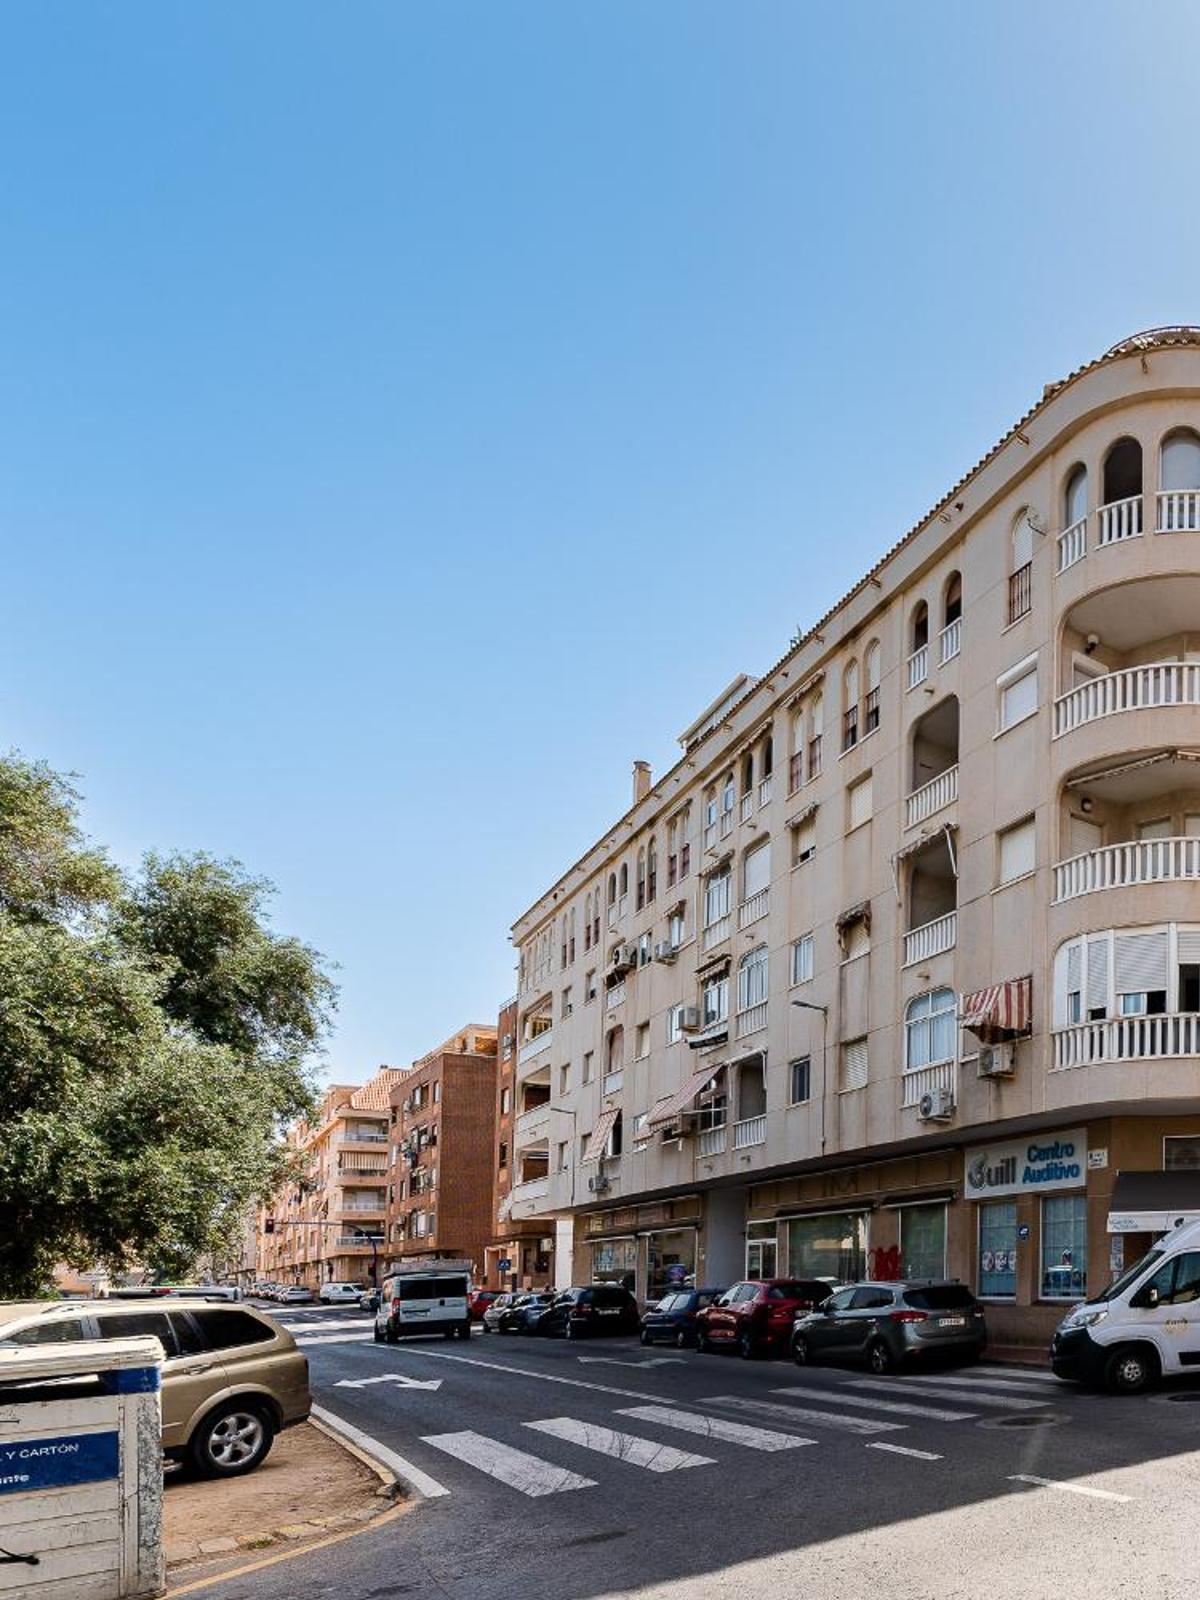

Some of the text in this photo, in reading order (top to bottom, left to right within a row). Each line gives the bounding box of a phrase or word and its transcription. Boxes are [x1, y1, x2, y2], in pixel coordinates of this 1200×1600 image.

[1027, 1141, 1075, 1164] Centro
[1022, 1161, 1080, 1184] Auditivo
[5, 1442, 80, 1460] Y CARTÓN
[0, 1474, 30, 1485] nte
